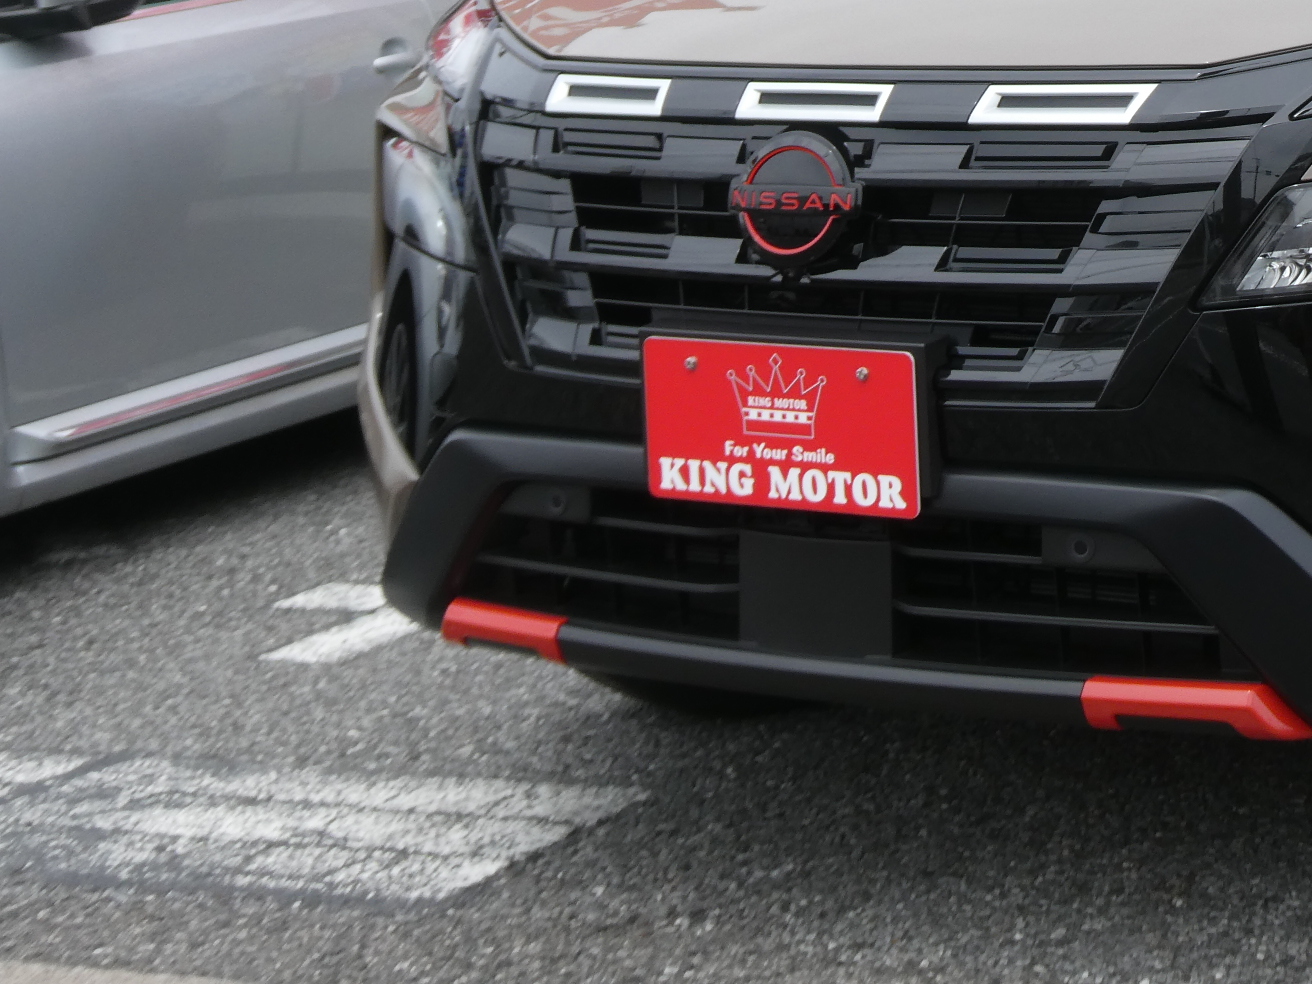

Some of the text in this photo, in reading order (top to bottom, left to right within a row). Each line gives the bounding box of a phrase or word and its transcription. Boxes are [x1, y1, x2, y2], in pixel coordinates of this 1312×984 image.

[732, 189, 852, 211] NISSAN
[748, 396, 808, 411] KING MOTOR
[724, 440, 835, 465] For Your Smile
[658, 456, 907, 510] KING MOTOR
